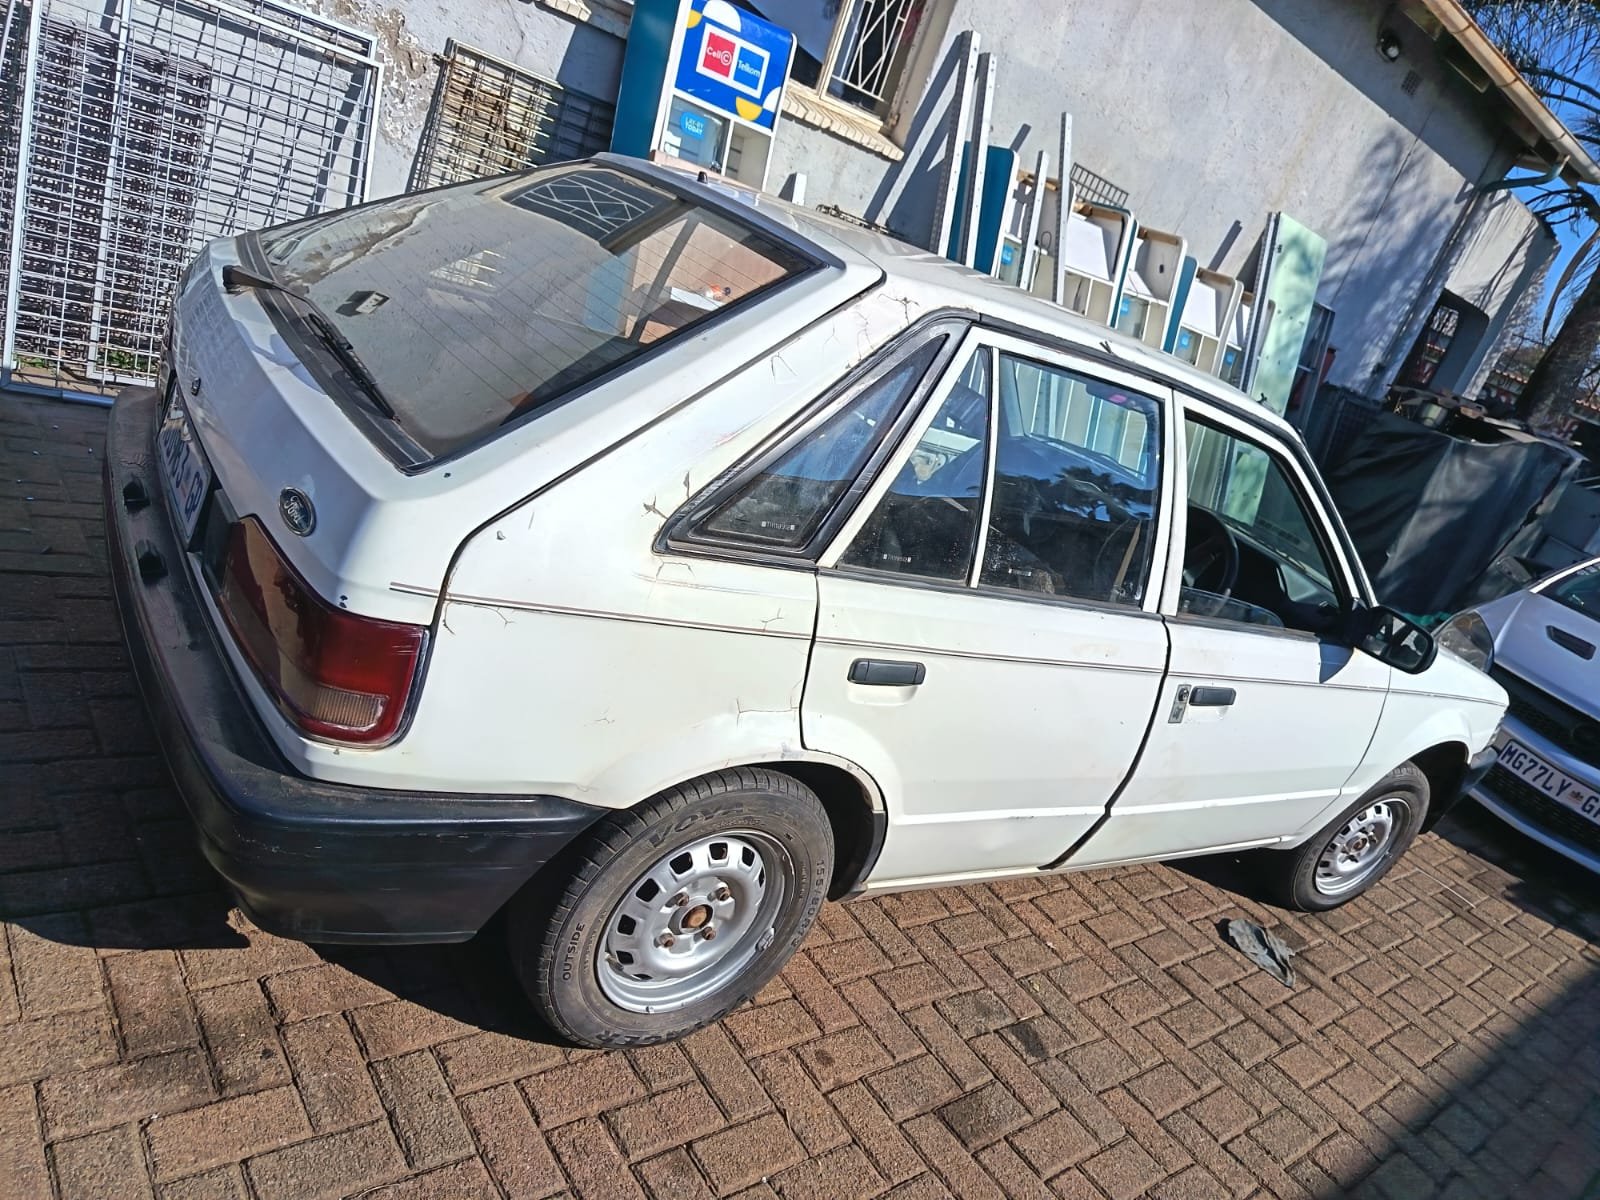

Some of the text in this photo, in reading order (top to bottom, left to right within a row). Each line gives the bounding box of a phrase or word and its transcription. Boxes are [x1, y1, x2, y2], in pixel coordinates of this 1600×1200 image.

[738, 60, 761, 78] Telkom
[1501, 744, 1571, 798] MG77LY
[562, 922, 586, 981] OUTSIDE
